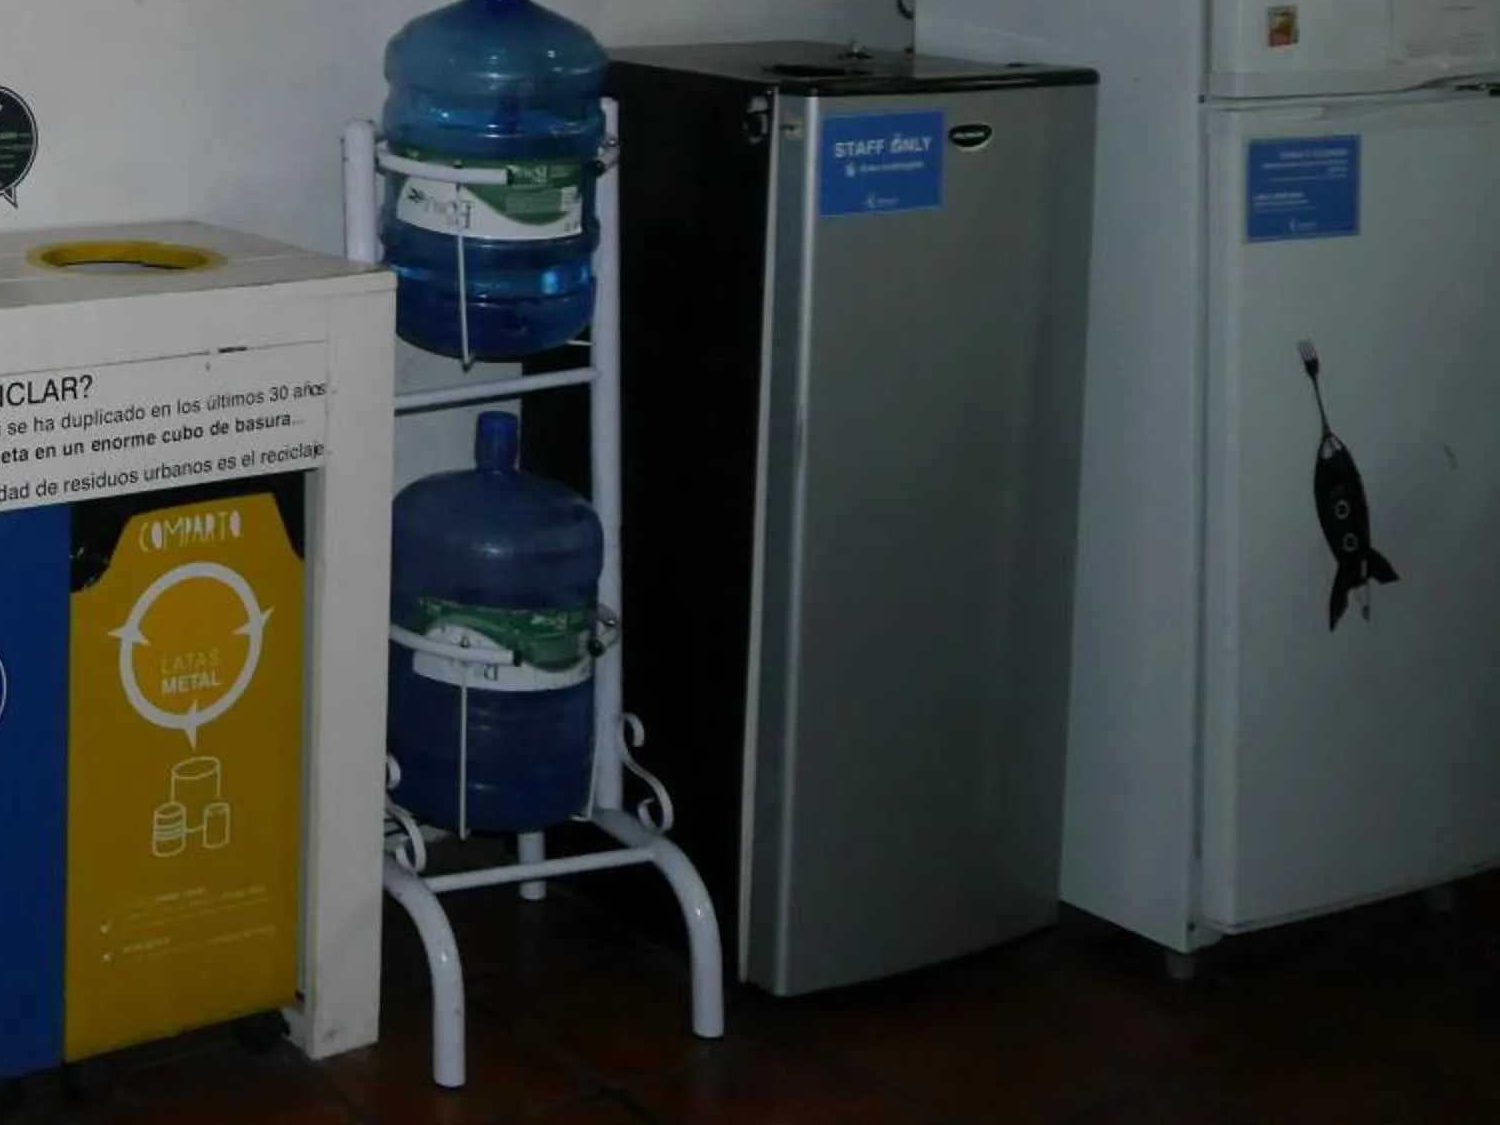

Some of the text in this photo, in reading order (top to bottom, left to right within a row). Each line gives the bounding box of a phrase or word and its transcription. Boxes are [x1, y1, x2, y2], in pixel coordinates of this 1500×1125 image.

[833, 135, 934, 159] STAFF ONLY
[7, 418, 28, 436] se
[33, 412, 55, 432] ha
[61, 400, 145, 432] duplicado
[151, 402, 171, 419] en
[177, 397, 201, 415] los
[206, 388, 265, 410] últimos
[269, 384, 289, 402] 30
[35, 443, 56, 460] en
[63, 440, 85, 457] un
[91, 430, 156, 452] enorme
[162, 422, 204, 444] cubo
[210, 418, 229, 436] de
[36, 476, 58, 497] de
[64, 464, 139, 493] residuos
[143, 456, 213, 481] urbanos
[218, 452, 236, 469] es
[241, 449, 256, 467] el
[160, 648, 221, 675] LATAS
[161, 671, 223, 696] METAL
